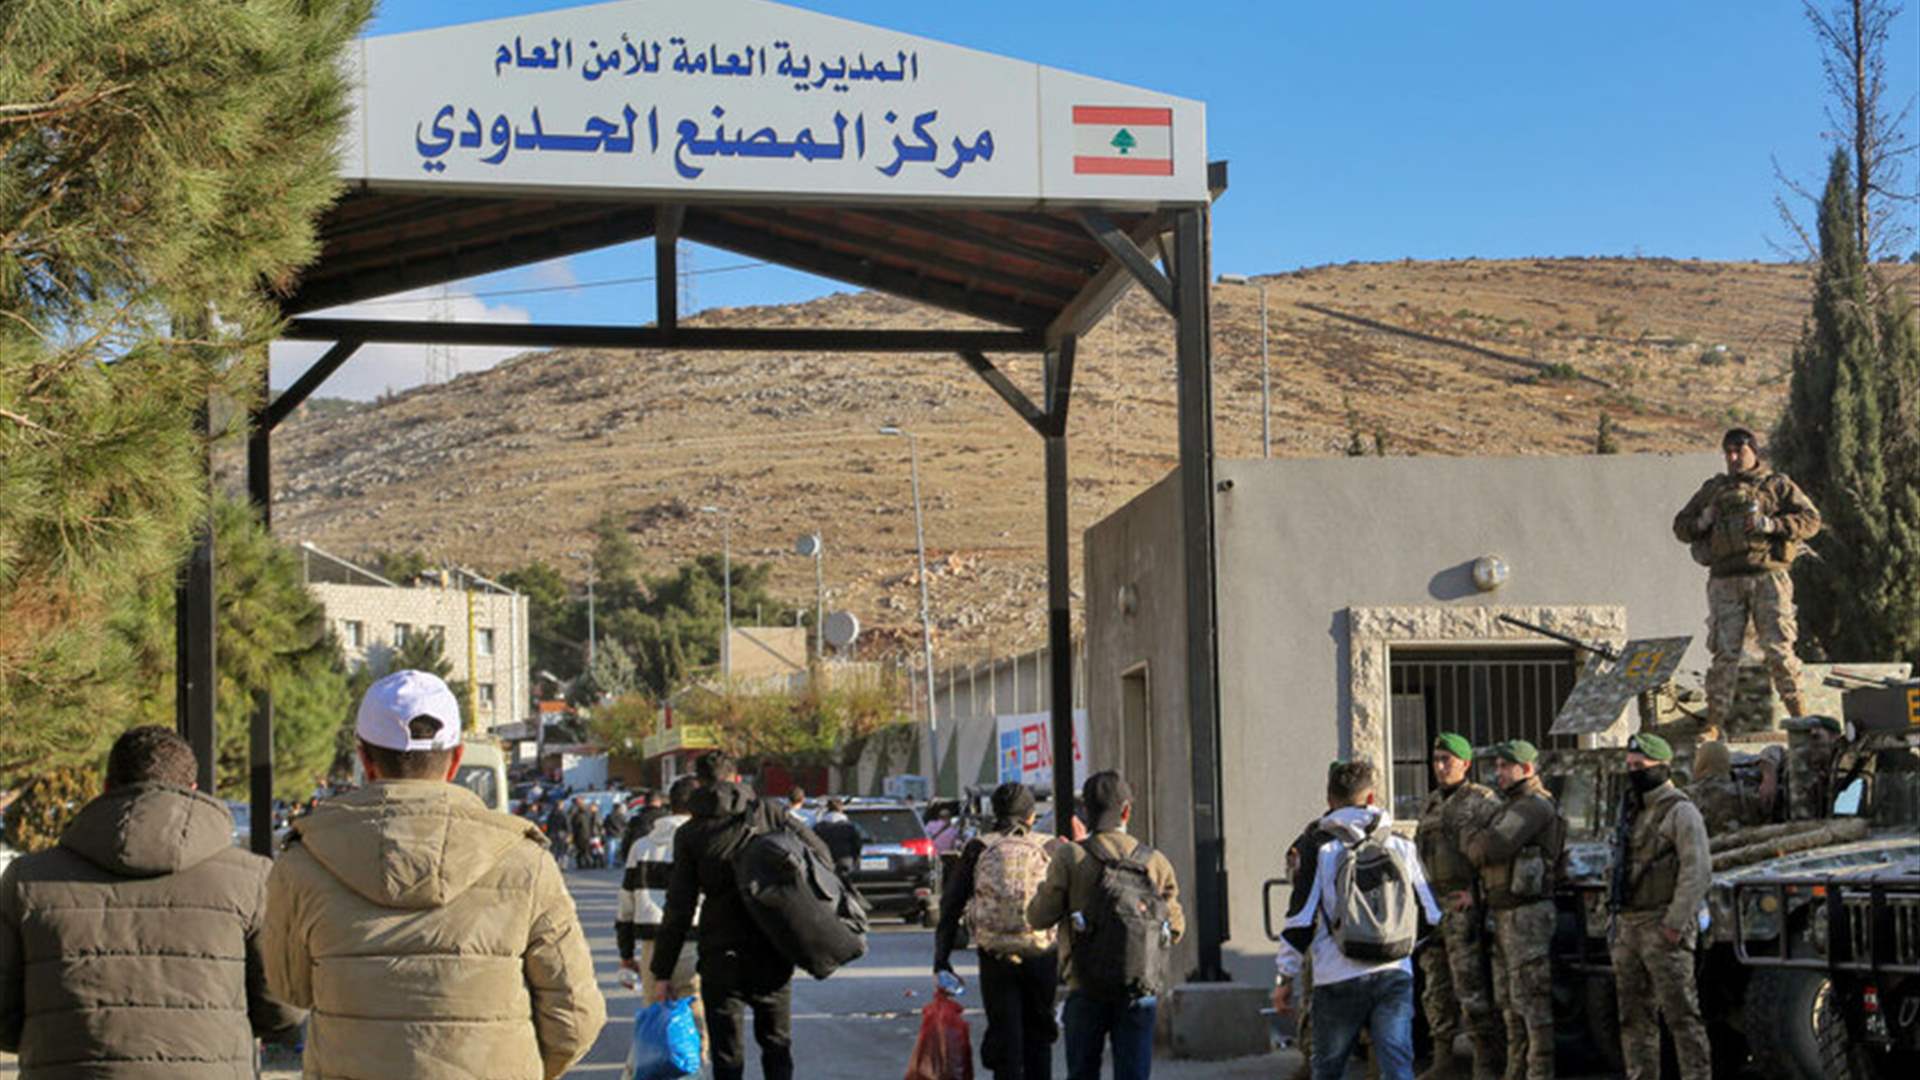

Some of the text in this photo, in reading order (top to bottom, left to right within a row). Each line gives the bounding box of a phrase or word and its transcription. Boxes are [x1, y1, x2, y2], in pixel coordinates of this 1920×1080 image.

[494, 33, 918, 93] المديرية العامة للأمن العام
[415, 103, 995, 180] مركز المصنع الحدودي
[1627, 651, 1664, 677] E1
